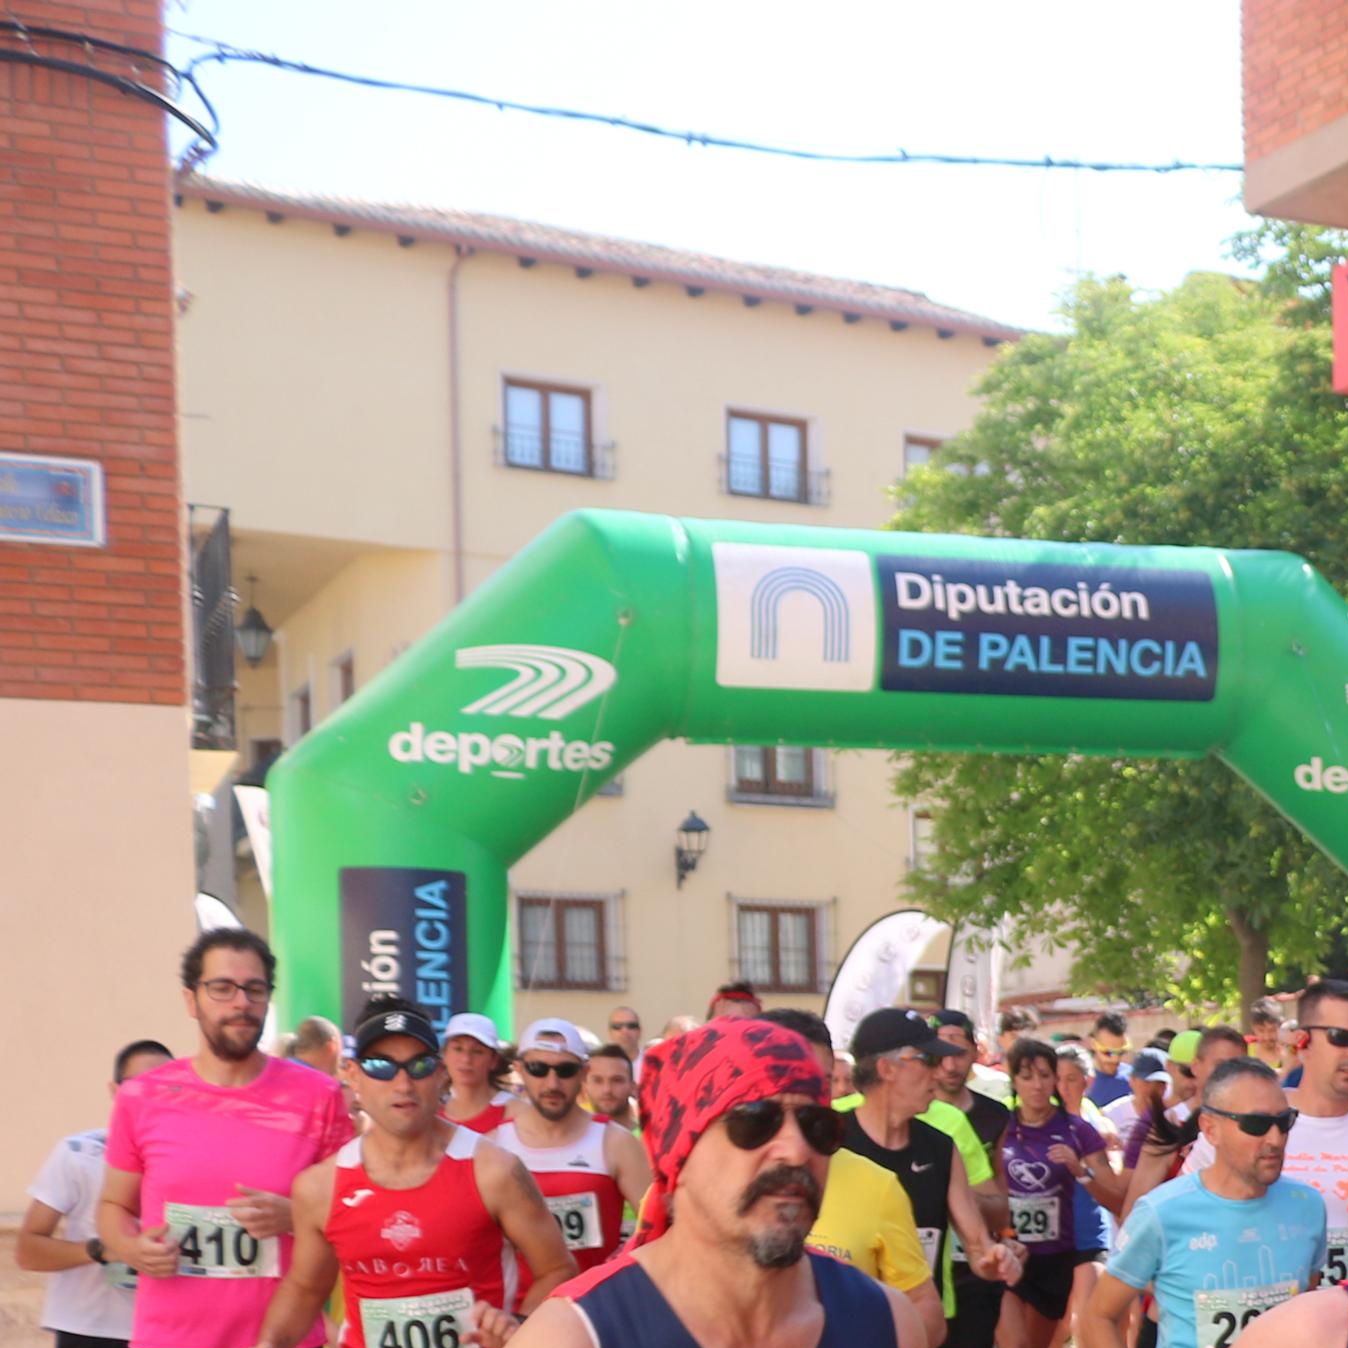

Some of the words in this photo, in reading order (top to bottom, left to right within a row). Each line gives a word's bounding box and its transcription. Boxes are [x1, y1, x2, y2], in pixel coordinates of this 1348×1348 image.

[894, 571, 1149, 622] Diputación
[898, 628, 965, 671] DE
[977, 631, 1208, 679] PALENCIA
[387, 721, 615, 777] deportes
[414, 880, 450, 1045] LENCIA
[179, 1225, 258, 1266] 410
